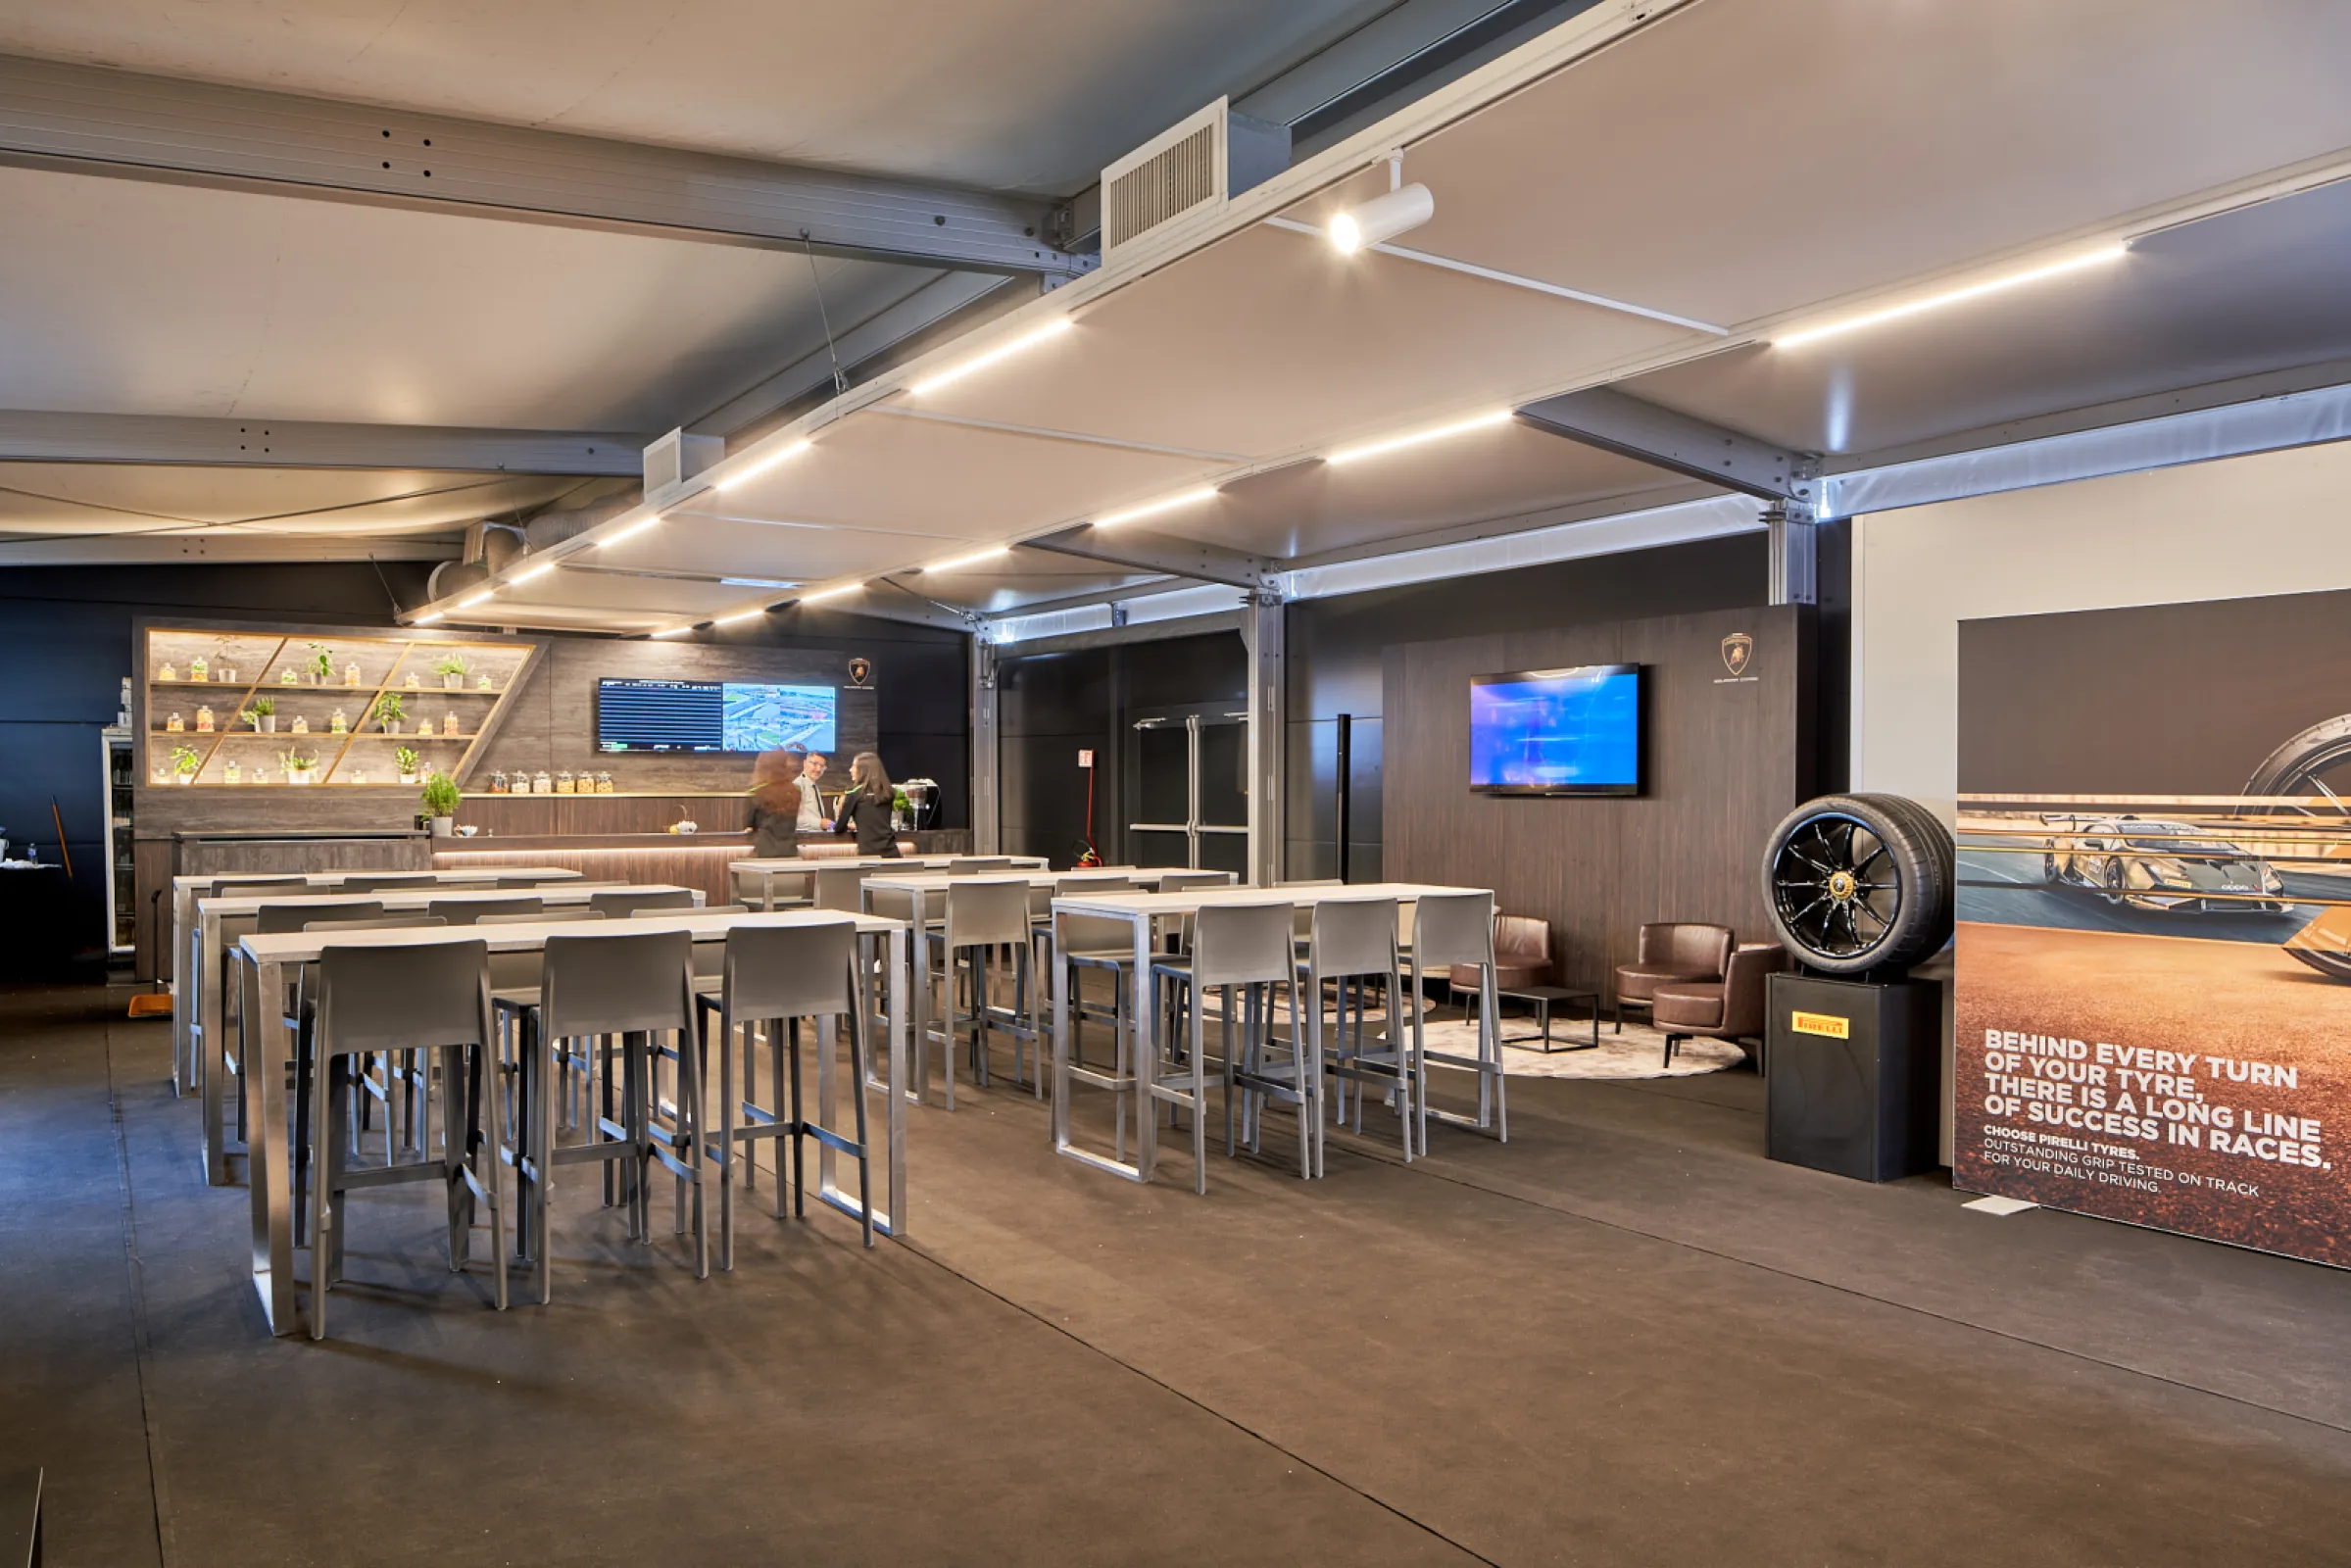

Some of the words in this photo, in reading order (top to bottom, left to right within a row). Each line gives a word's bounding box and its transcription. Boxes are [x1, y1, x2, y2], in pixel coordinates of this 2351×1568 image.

[1797, 1016, 1843, 1034] PIRELLI
[1984, 1052, 2022, 1073] OF
[2029, 1056, 2107, 1086] YOUR
[2115, 1068, 2204, 1104] TYRE,
[1985, 1029, 2088, 1060] BEHIND
[2096, 1043, 2197, 1074] EVERY
[2205, 1056, 2297, 1089] TURN
[1984, 1072, 2073, 1103] THERE
[2081, 1086, 2107, 1109] IS
[2115, 1092, 2137, 1114] A
[2146, 1096, 2234, 1128] LONG
[2244, 1109, 2322, 1143] LINE
[1984, 1095, 2021, 1116] OF
[2028, 1102, 2160, 1141] SUCCESS
[2168, 1122, 2199, 1149] IN
[2209, 1129, 2331, 1170] RACES.
[1984, 1125, 2036, 1143] CHOOSE
[2039, 1133, 2088, 1152] PIRELLI
[2091, 1143, 2140, 1160] TYRES.
[1984, 1138, 2079, 1163] OUTSTANDING
[2082, 1154, 2115, 1169] GRIP
[2119, 1161, 2174, 1181] TESTED
[2179, 1172, 2201, 1187] ON
[2206, 1176, 2260, 1197] TRACK
[1984, 1151, 2010, 1164] FOR
[2014, 1155, 2051, 1172] YOUR
[2054, 1163, 2094, 1180] DAILY
[2099, 1172, 2162, 1194] DRIVING.
